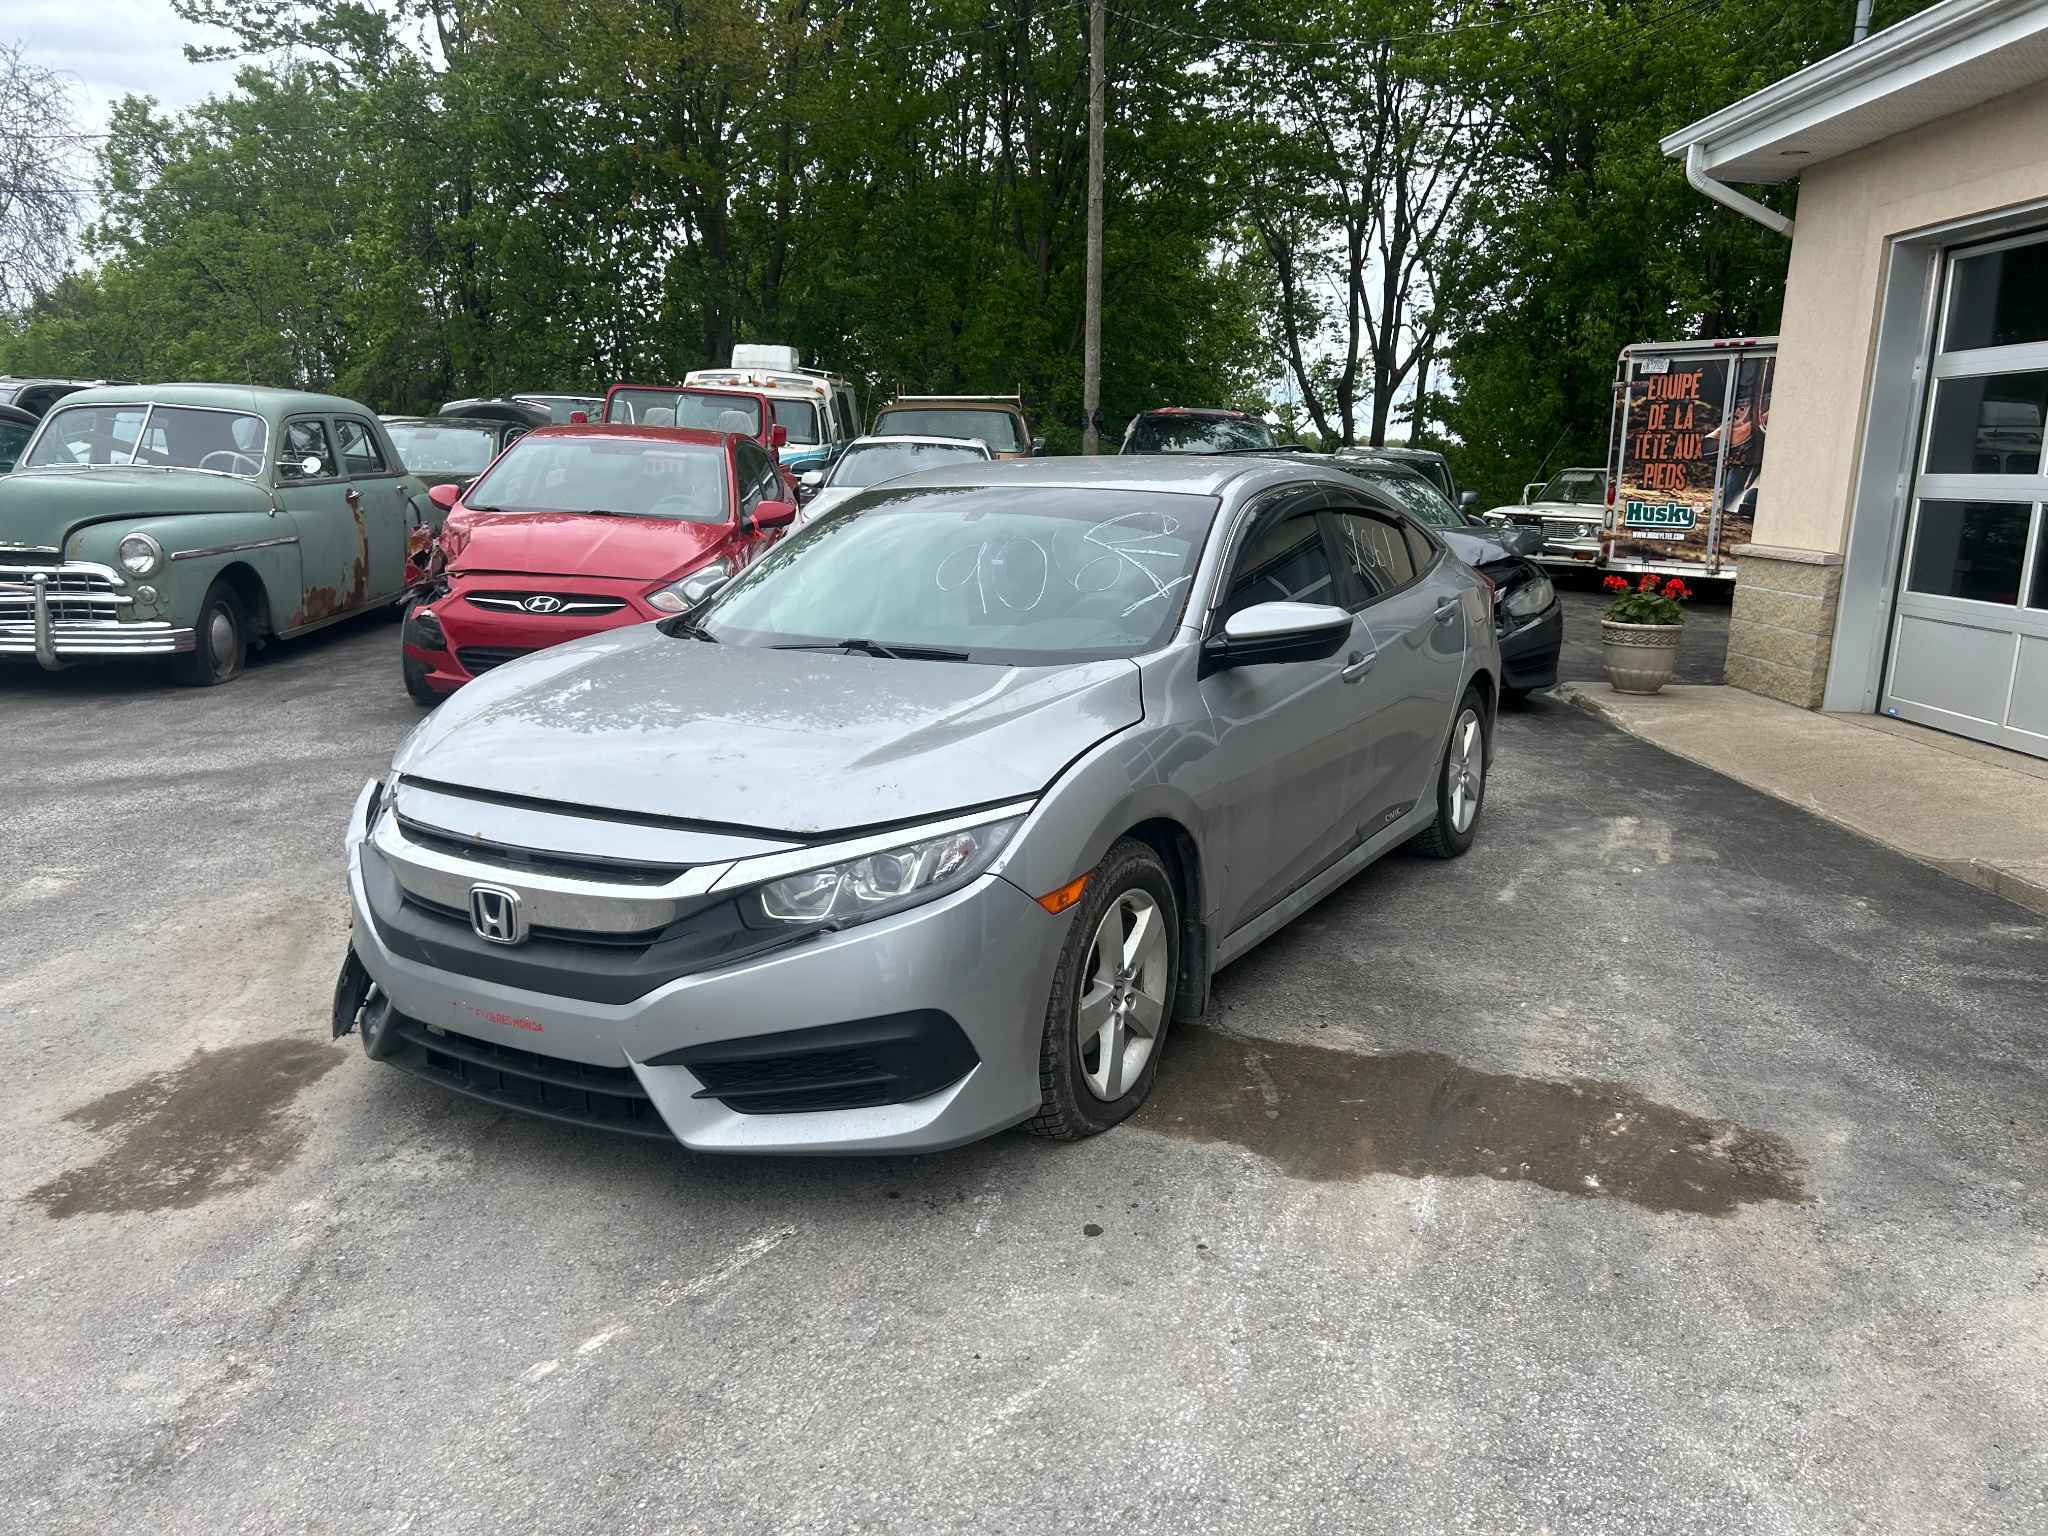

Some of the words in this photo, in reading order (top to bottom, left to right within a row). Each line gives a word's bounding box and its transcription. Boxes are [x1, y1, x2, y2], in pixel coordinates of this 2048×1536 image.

[1648, 403, 1669, 430] DE
[1674, 402, 1695, 430] LA
[1633, 430, 1671, 460] TÊTE
[1673, 433, 1704, 460] AUX
[1643, 463, 1687, 491] PIEDS
[1626, 501, 1694, 527] Husky
[512, 1017, 544, 1033] HONDA
